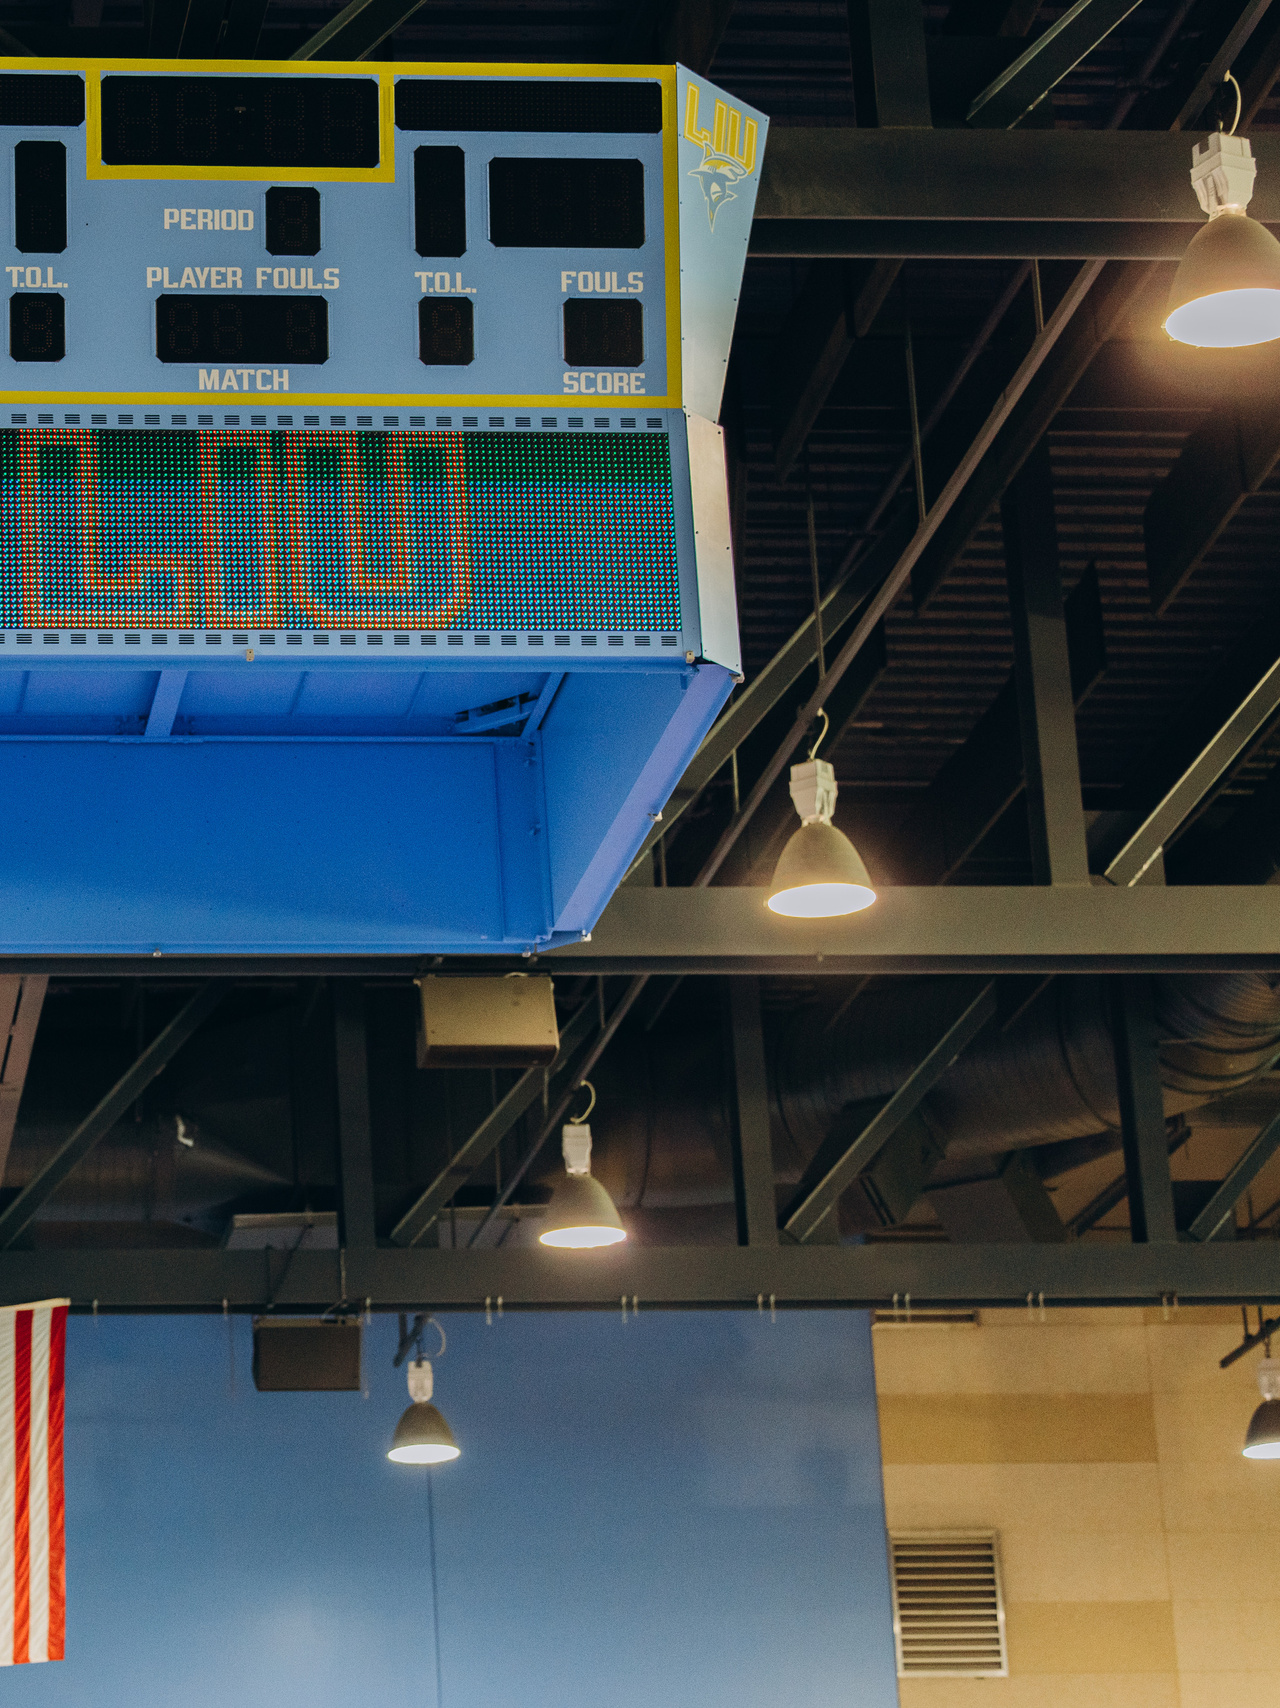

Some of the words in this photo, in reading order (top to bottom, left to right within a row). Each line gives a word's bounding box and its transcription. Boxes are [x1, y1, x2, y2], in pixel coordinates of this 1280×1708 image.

[683, 81, 759, 176] LIU
[163, 208, 254, 232] PERIOD
[6, 265, 69, 289] T.O.L.
[146, 266, 243, 290] PLAYER
[255, 267, 340, 291] FOULS
[414, 271, 477, 294] T.O.L.
[560, 270, 644, 294] FOULS
[198, 368, 290, 392] MATCH
[562, 371, 646, 395] SCORE
[19, 427, 472, 631] LIU
